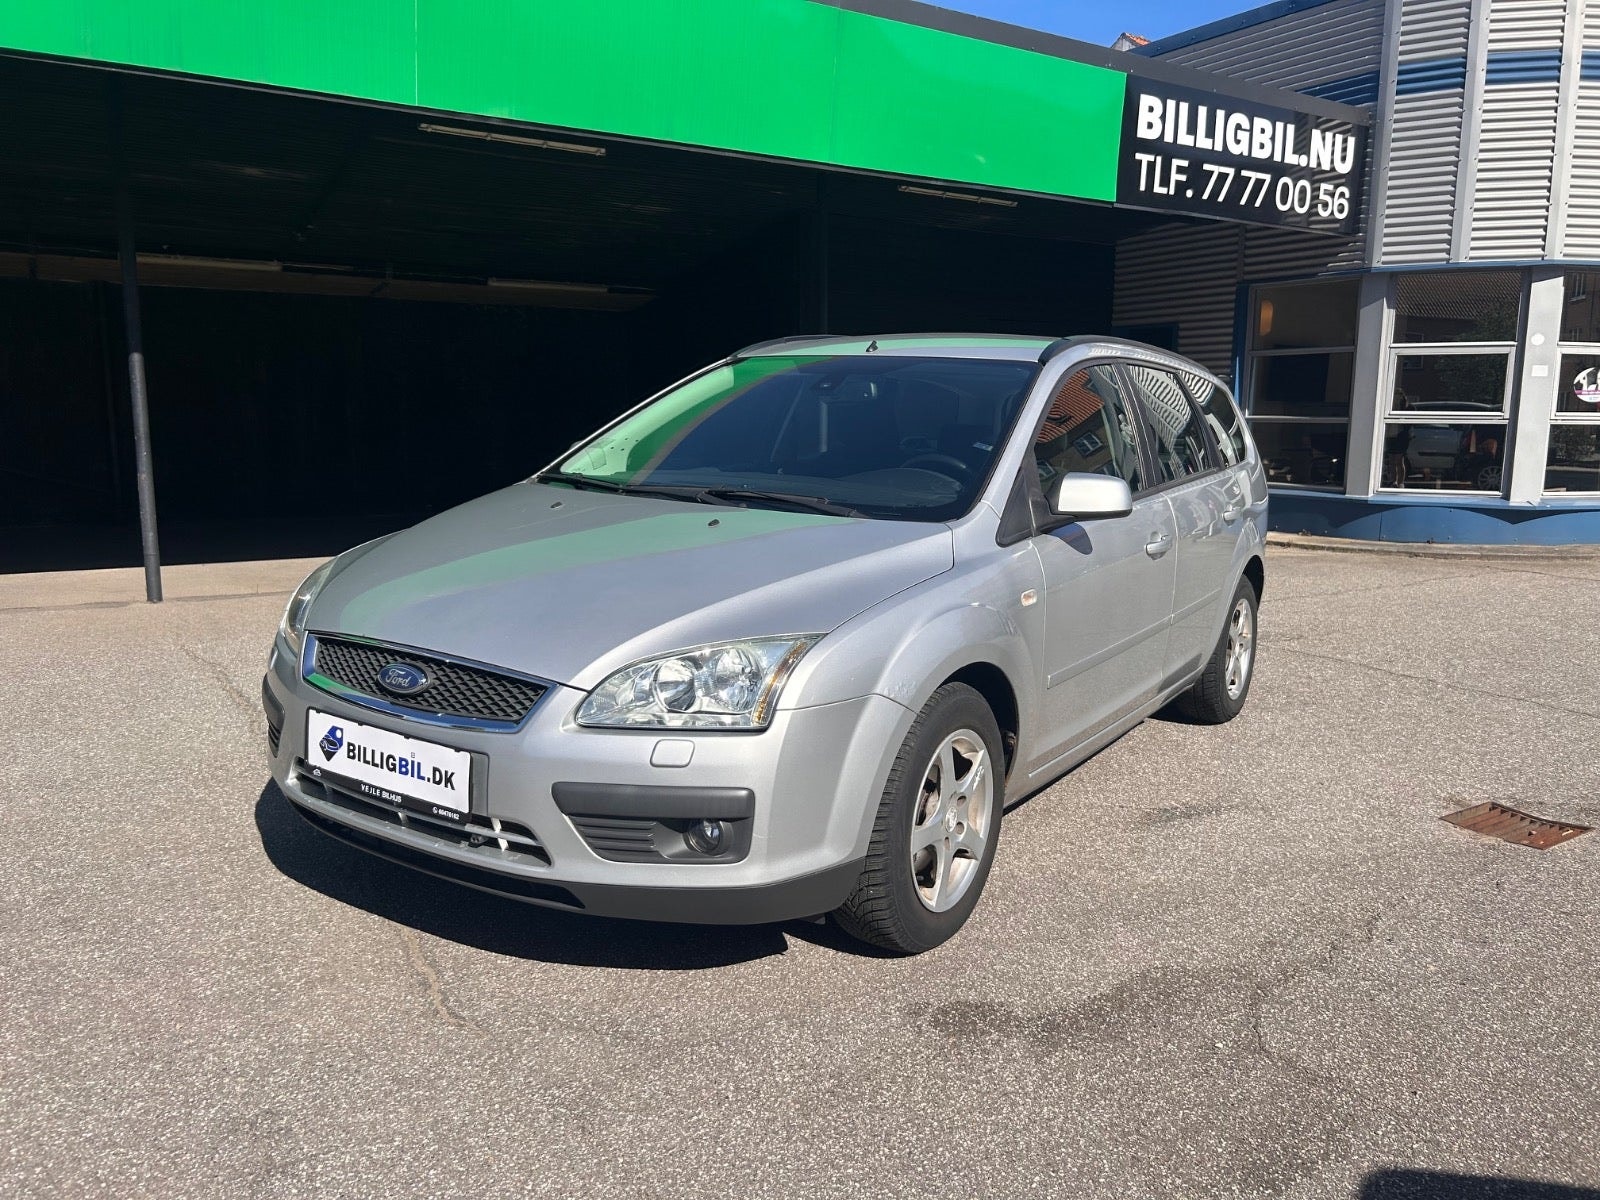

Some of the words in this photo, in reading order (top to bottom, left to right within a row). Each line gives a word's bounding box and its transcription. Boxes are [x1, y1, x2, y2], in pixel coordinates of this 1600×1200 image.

[1136, 93, 1356, 174] BILLIGBIL.NU
[1134, 152, 1194, 198] TLF.
[1201, 163, 1235, 202] 77
[1239, 169, 1272, 208] 77
[1275, 176, 1311, 214] 00
[1317, 182, 1350, 220] 56
[385, 668, 412, 687] Ford
[346, 741, 456, 791] BILLIGBIL.DK
[361, 783, 381, 796] VEJLE
[381, 791, 402, 803] BILHUS
